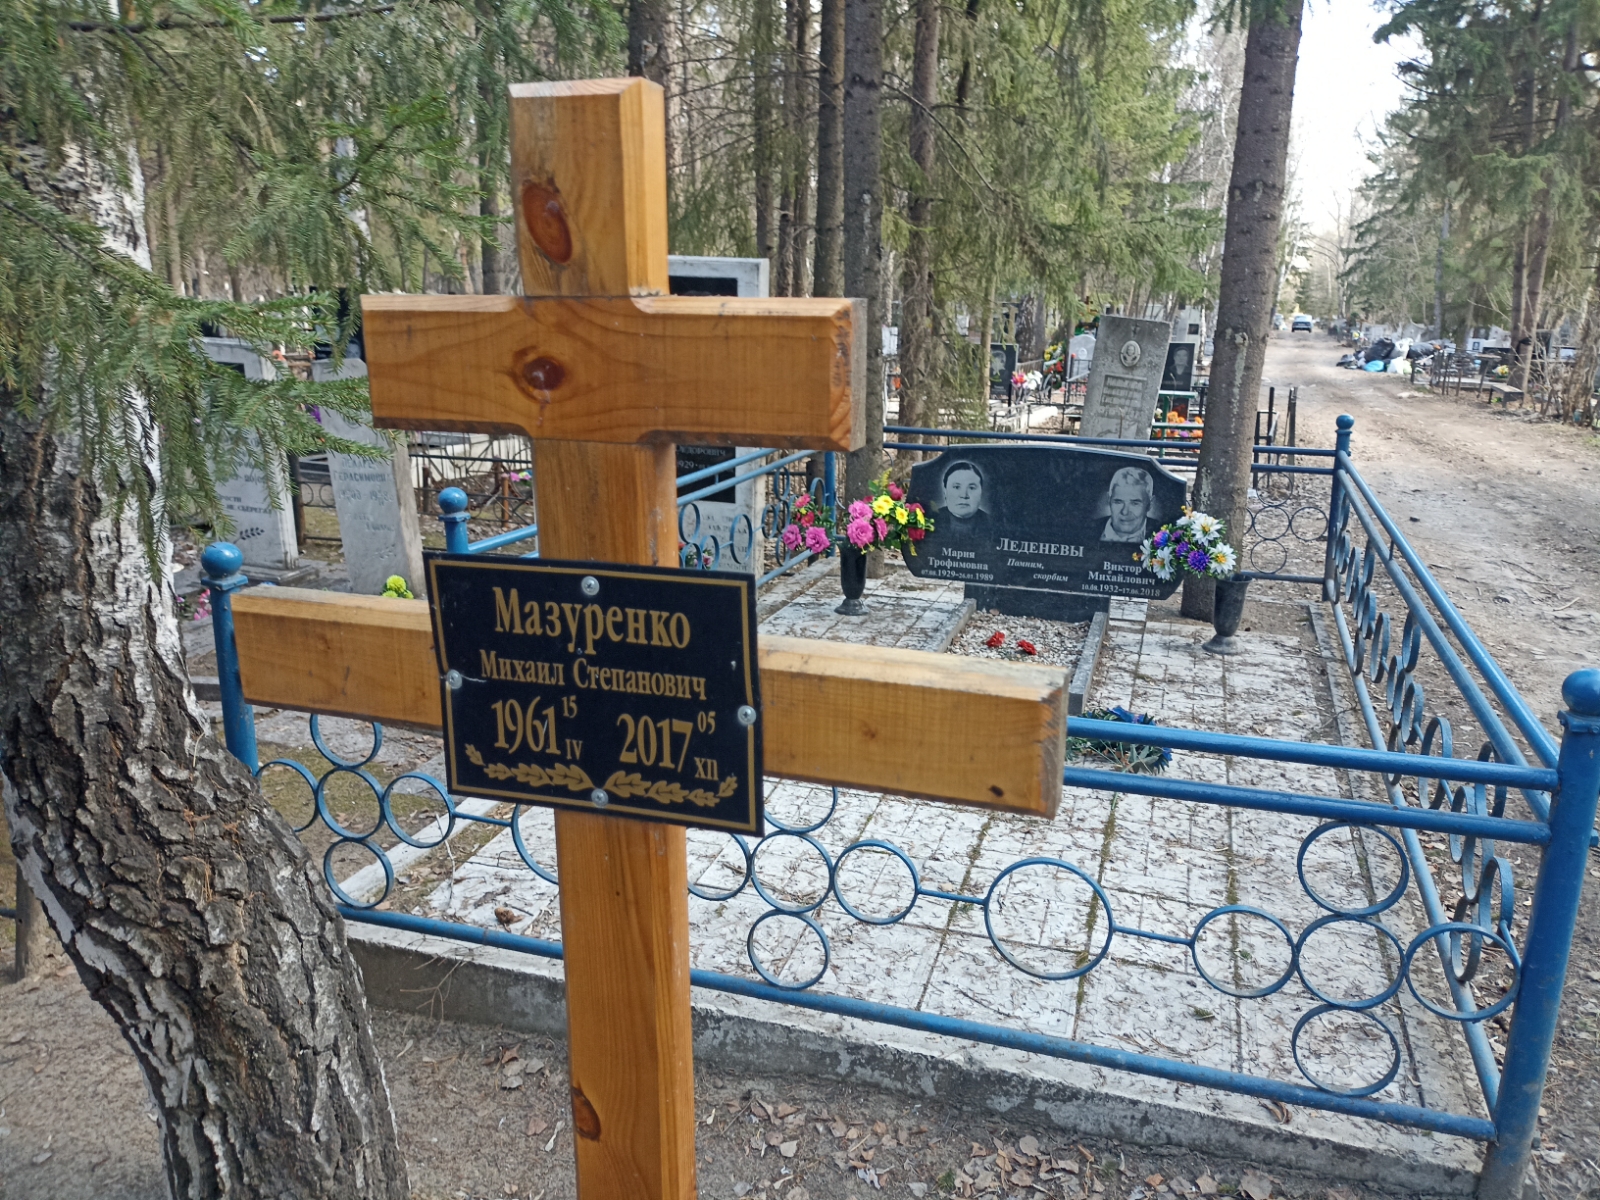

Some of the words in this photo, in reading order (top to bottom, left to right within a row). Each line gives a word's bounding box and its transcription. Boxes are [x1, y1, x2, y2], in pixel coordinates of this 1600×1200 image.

[942, 547, 975, 559] Мария
[996, 538, 1084, 558] ЛЕДЕНЕВЫ
[927, 557, 989, 571] Трофимовна
[1103, 561, 1142, 575] Виктор
[1033, 572, 1068, 583] скорбим
[1088, 571, 1155, 585] Михайлович
[492, 586, 691, 655] Мазуренко
[479, 649, 565, 686] Михаил
[573, 658, 707, 700] Степанович
[491, 696, 561, 755] 1961
[563, 695, 577, 719] 15
[616, 713, 694, 773] 2017
[697, 711, 716, 735] 05
